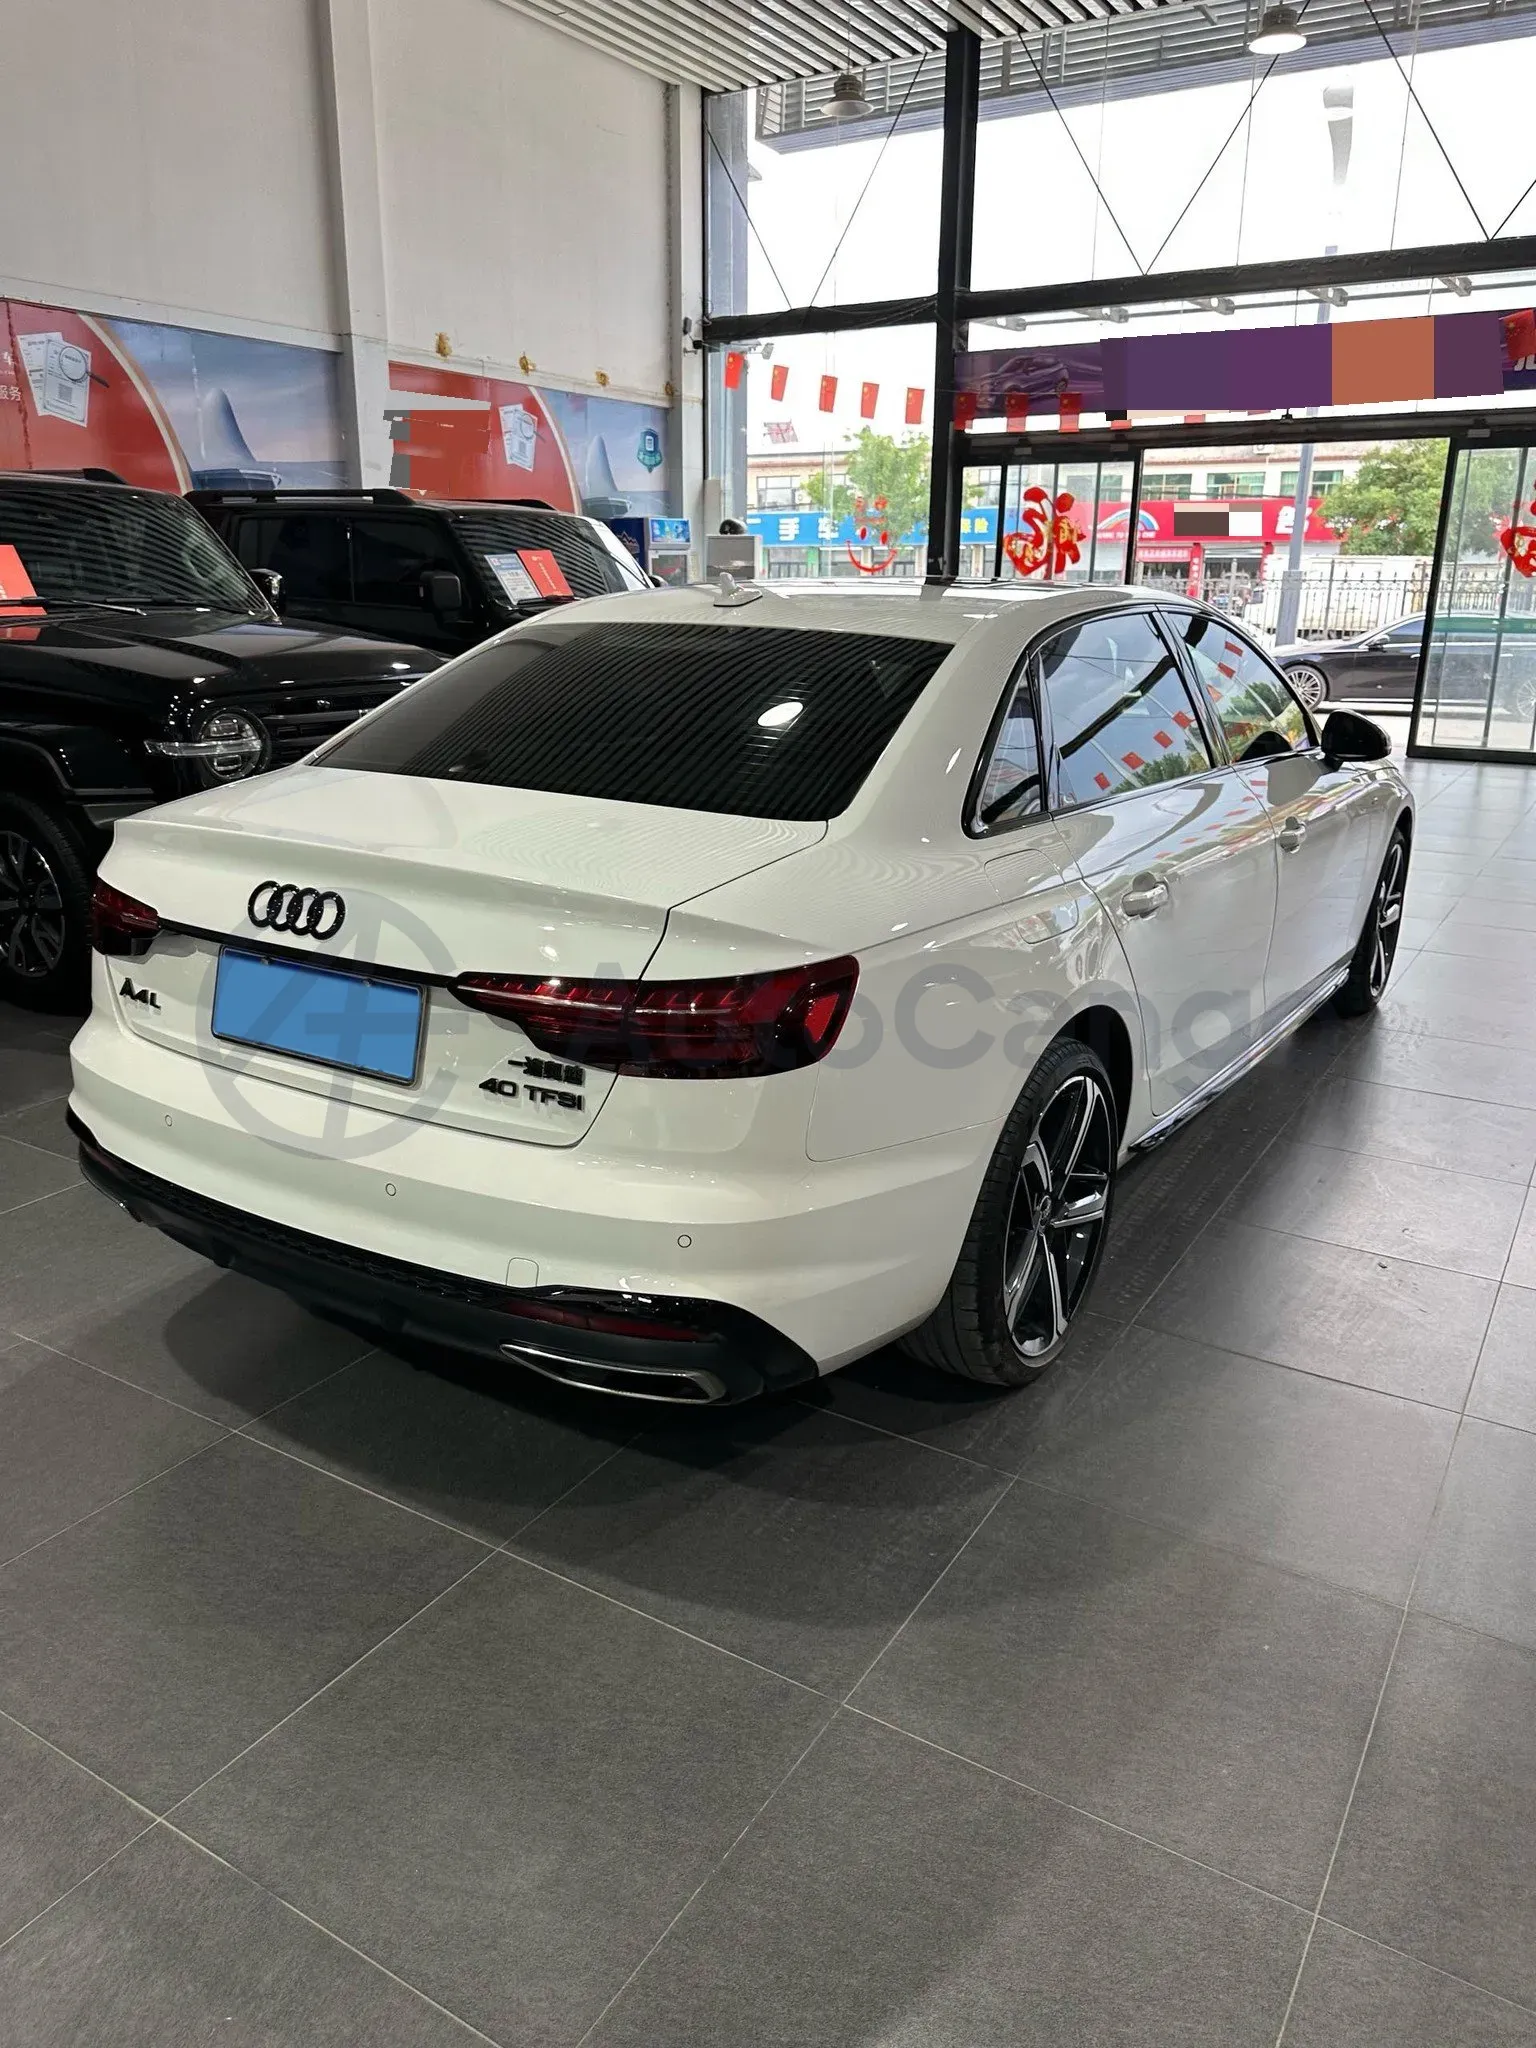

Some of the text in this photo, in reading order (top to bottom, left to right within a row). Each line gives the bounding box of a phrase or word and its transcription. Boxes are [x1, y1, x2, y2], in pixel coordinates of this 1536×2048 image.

[119, 977, 161, 1009] A4L
[479, 1078, 584, 1111] 40 TFSI
